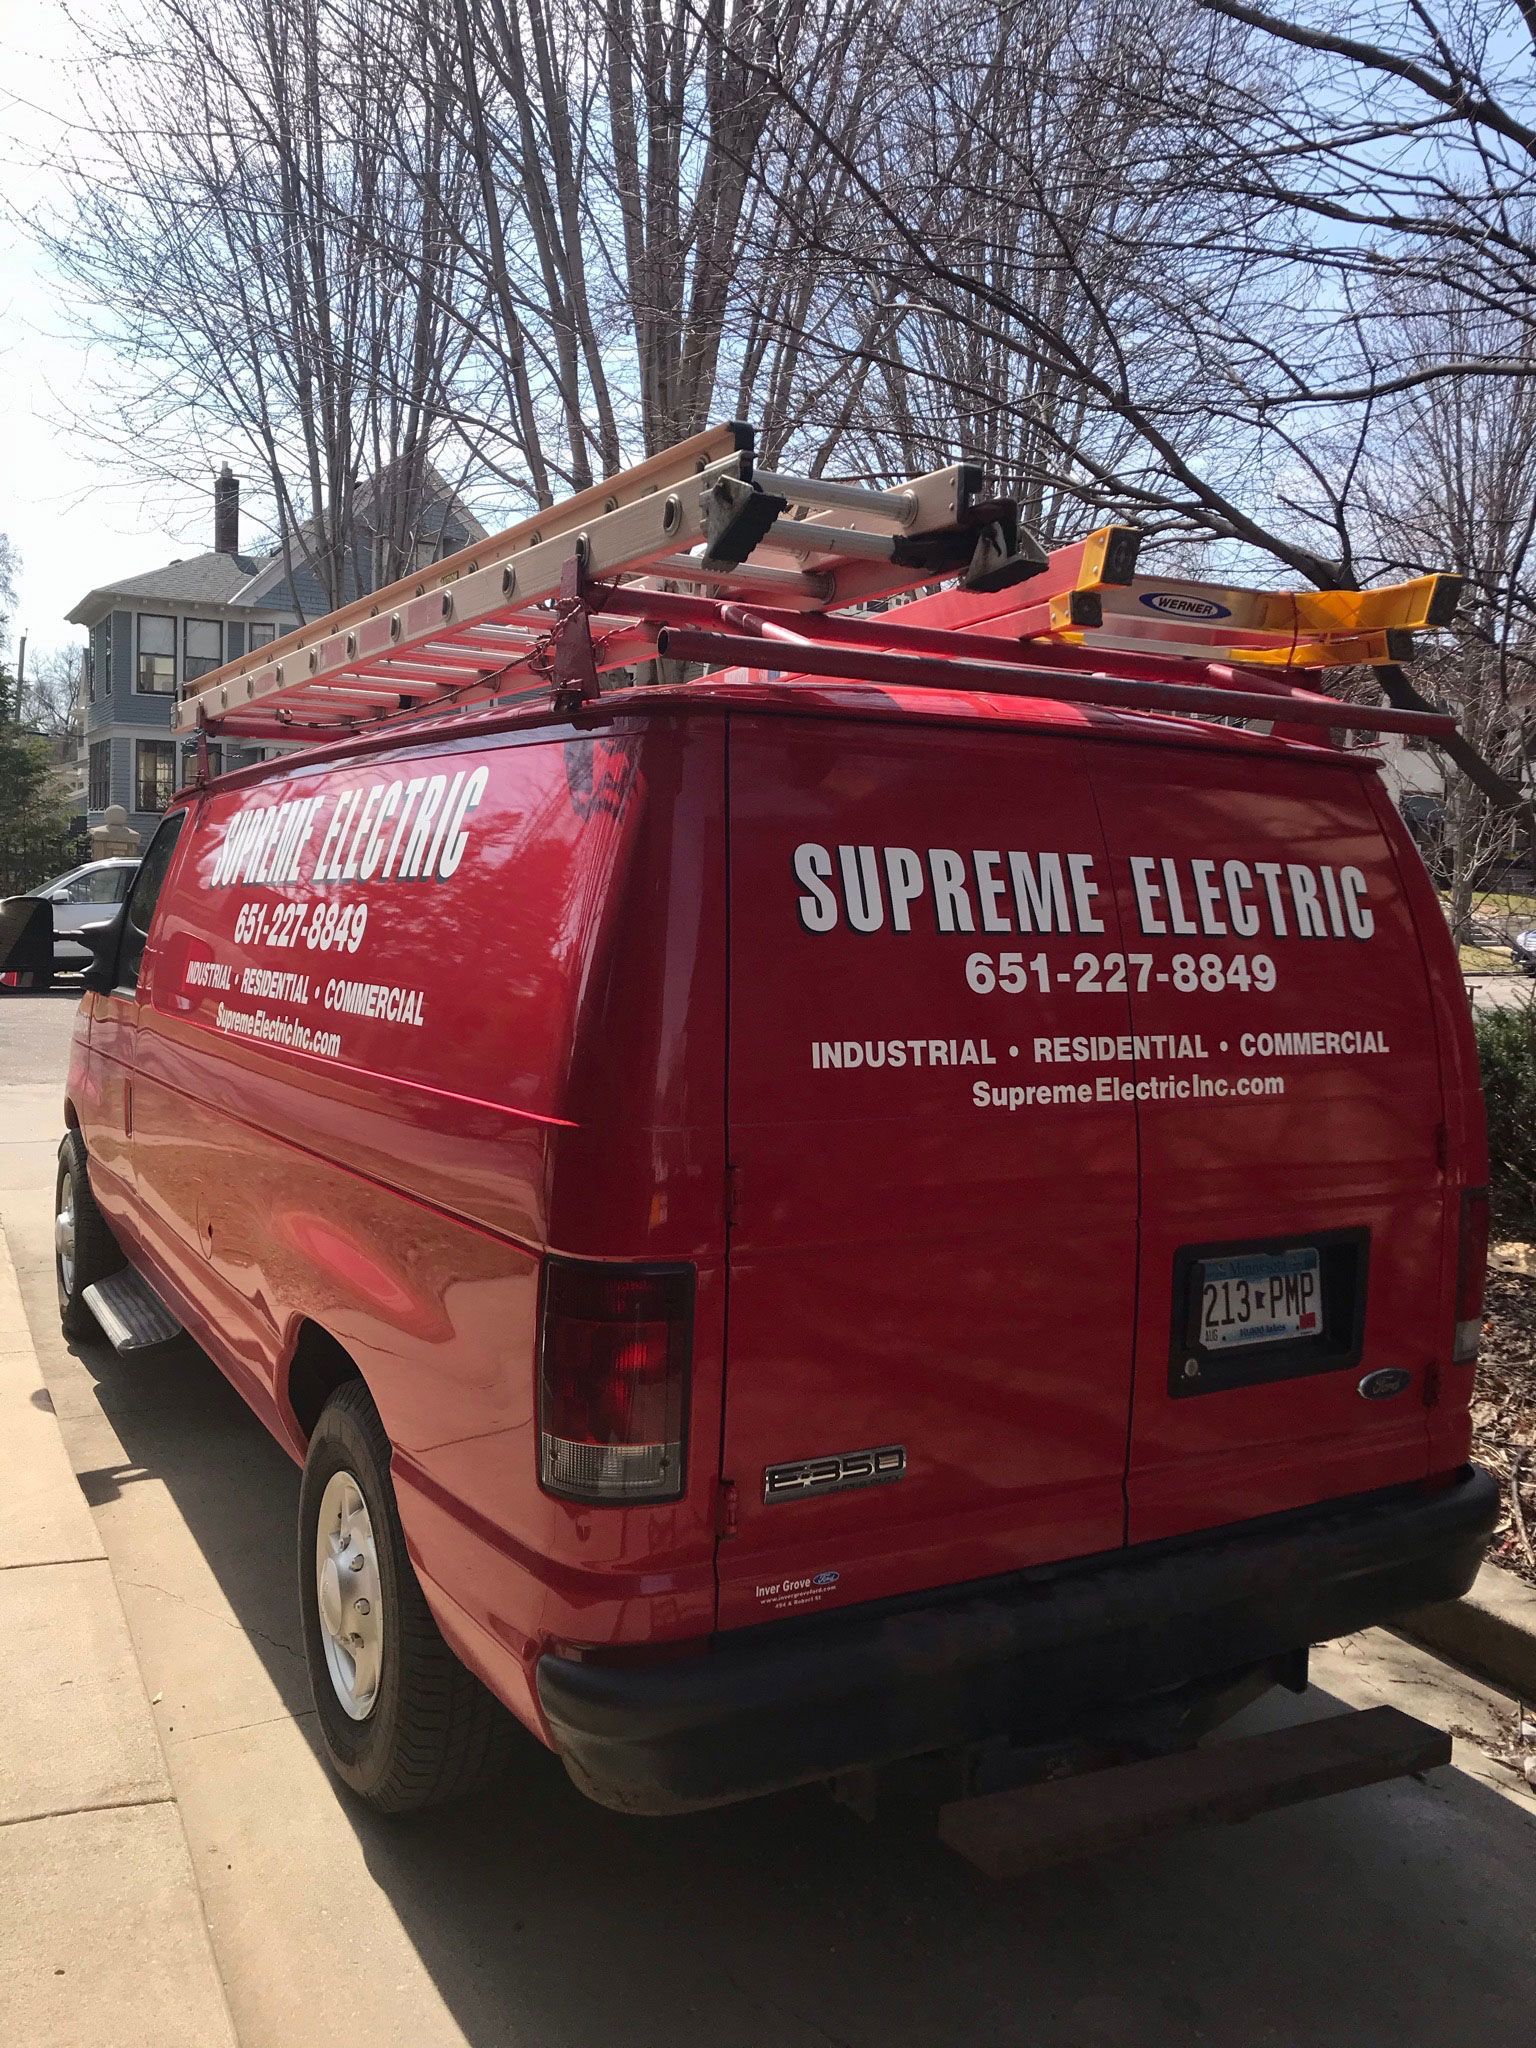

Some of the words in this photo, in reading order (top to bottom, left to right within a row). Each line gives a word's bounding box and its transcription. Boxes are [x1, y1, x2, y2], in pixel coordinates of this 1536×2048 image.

[1158, 597, 1213, 615] WERNER
[209, 794, 326, 887] SUPREME
[311, 765, 489, 884] ELECTRIC
[793, 841, 1105, 937] SUPREME
[1129, 855, 1376, 941] ELECTRIC
[233, 902, 368, 954] 651-227-8849
[185, 960, 231, 991] INDUSTRIAL
[240, 967, 310, 1005] RESIDENTIAL
[323, 978, 425, 1027] COMMERCIAL
[964, 951, 1277, 995] 651-227-8849
[215, 1001, 341, 1058] SupremeElectricInc.com
[811, 1039, 997, 1070] INDUSTRIAL
[1033, 1034, 1209, 1064] RESIDENTIAL
[1239, 1030, 1391, 1059] COMMERCIAL
[972, 1073, 1285, 1111] SupremeElectricInc.com
[1203, 1280, 1251, 1328] 213
[1269, 1272, 1314, 1319] PMP
[755, 1584, 780, 1598] Inver
[782, 1578, 811, 1592] Grove
